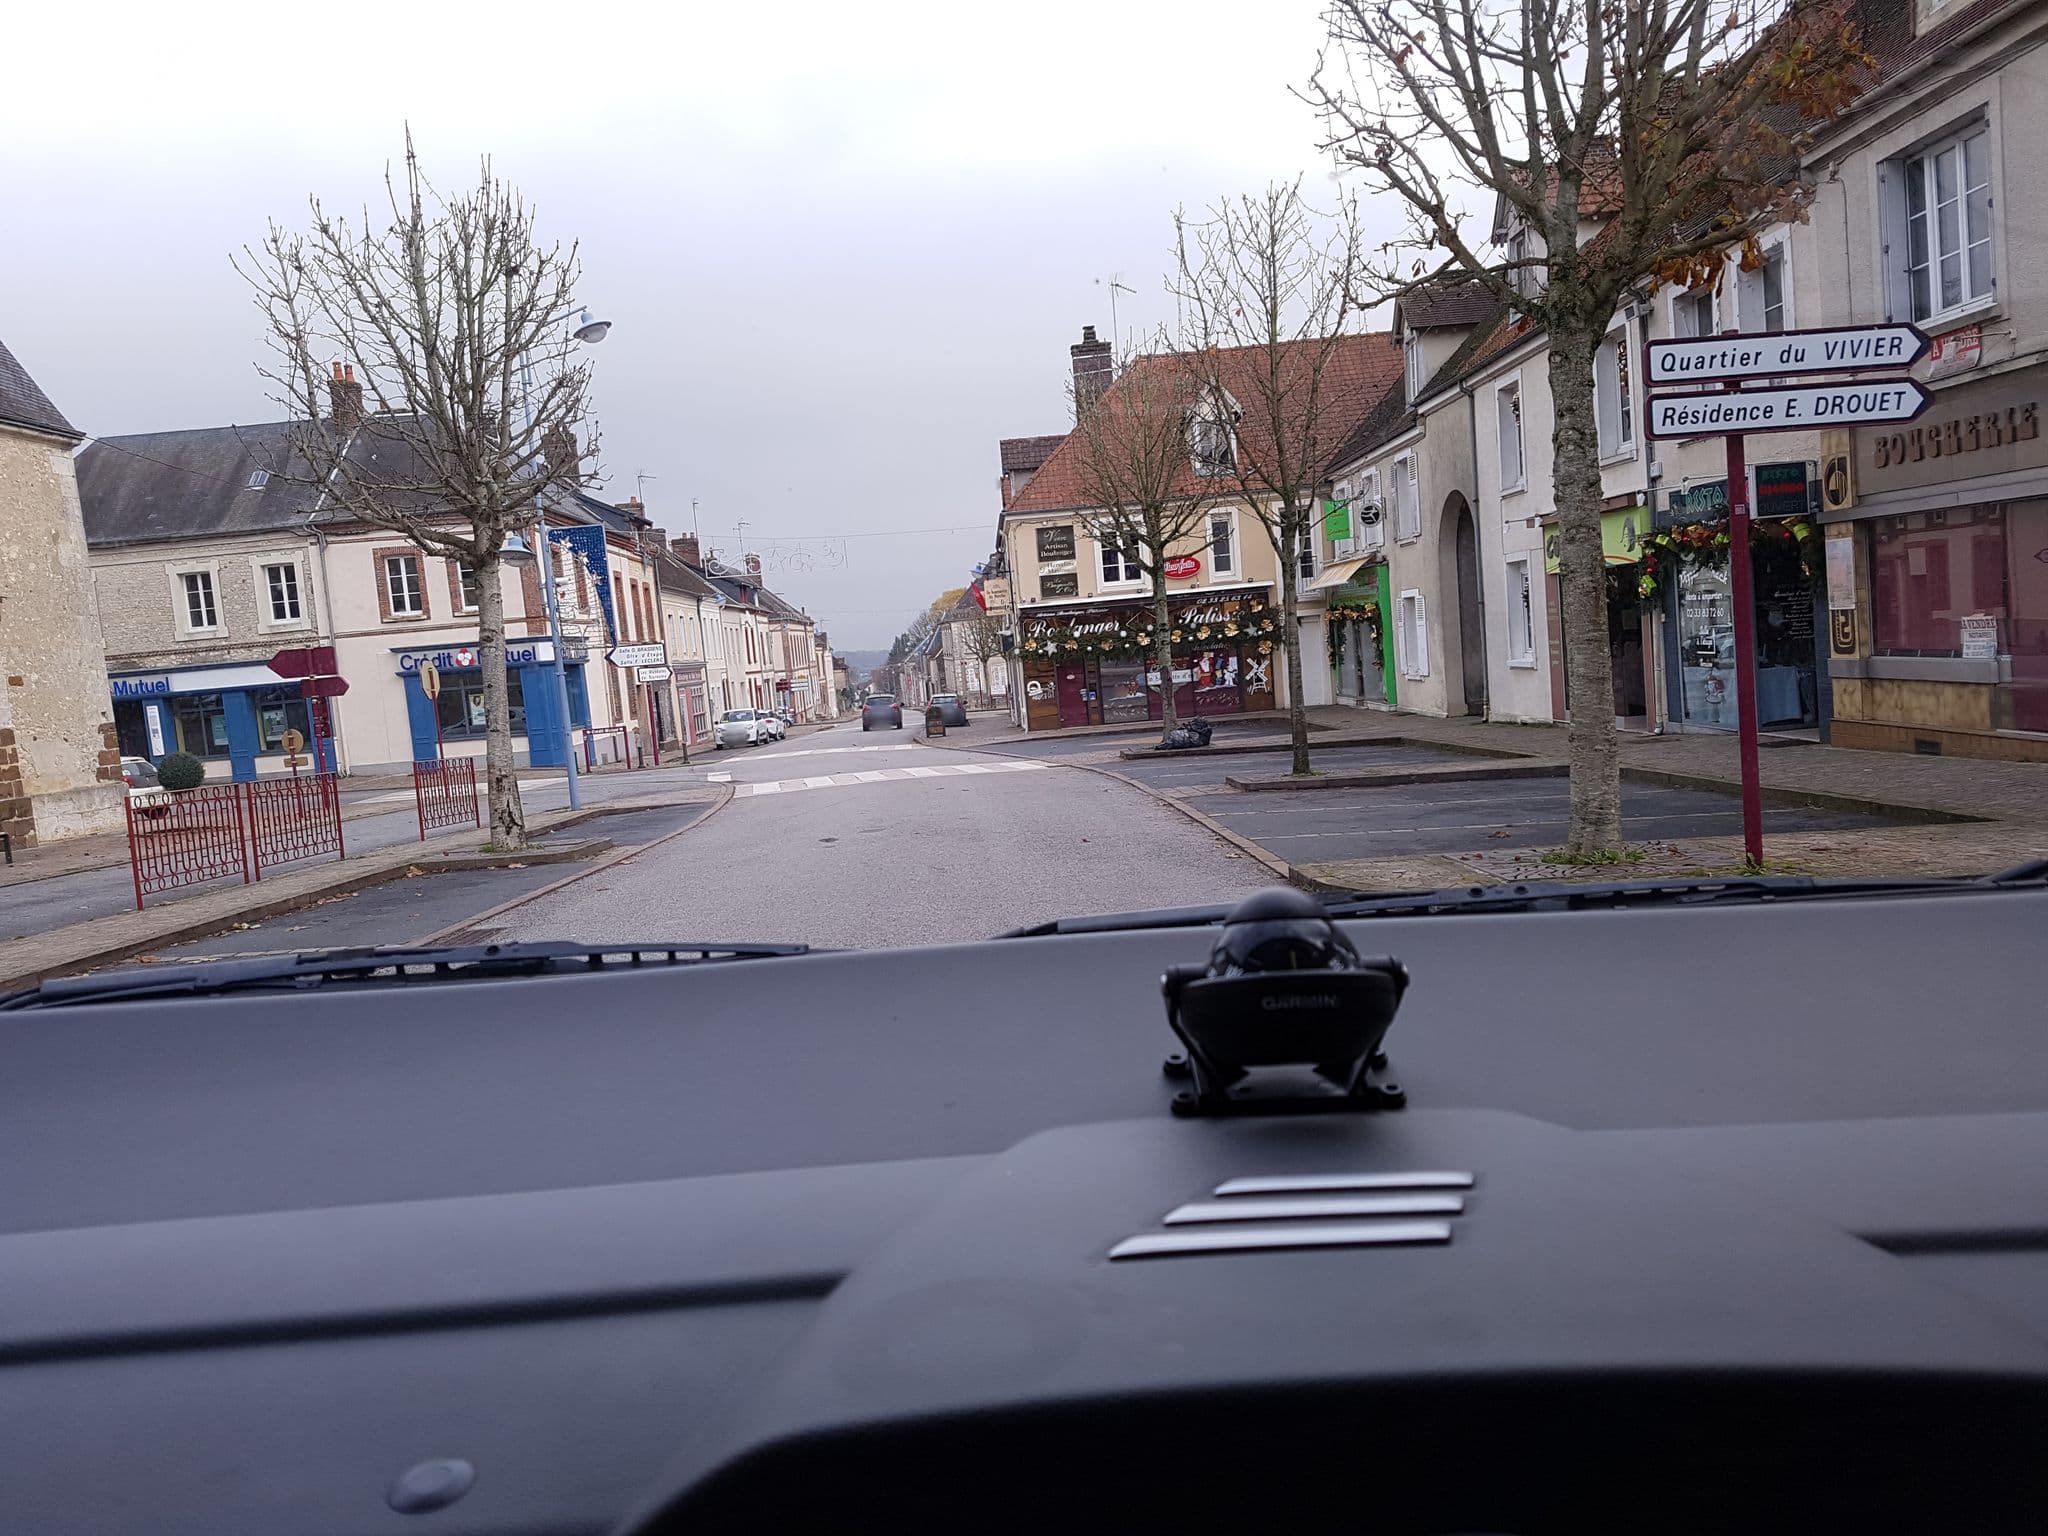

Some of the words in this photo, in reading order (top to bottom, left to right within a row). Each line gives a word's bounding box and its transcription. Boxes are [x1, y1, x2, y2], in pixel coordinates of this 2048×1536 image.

[1661, 347, 1762, 373] Quartier
[1779, 344, 1805, 364] du
[1824, 336, 1903, 361] VIVIER
[1662, 404, 1774, 426] Résidence
[1785, 399, 1802, 417] E.
[1814, 392, 1906, 415] DROUET
[1873, 402, 2039, 468] BOUCHERIE
[1040, 550, 1073, 558] Boulanger
[1687, 608, 1694, 617] 02
[1694, 608, 1702, 617] 33
[1710, 607, 1717, 617] 72
[1717, 607, 1725, 617] 60
[113, 677, 170, 696] Mutuel
[1262, 995, 1337, 1009] GARMIN
